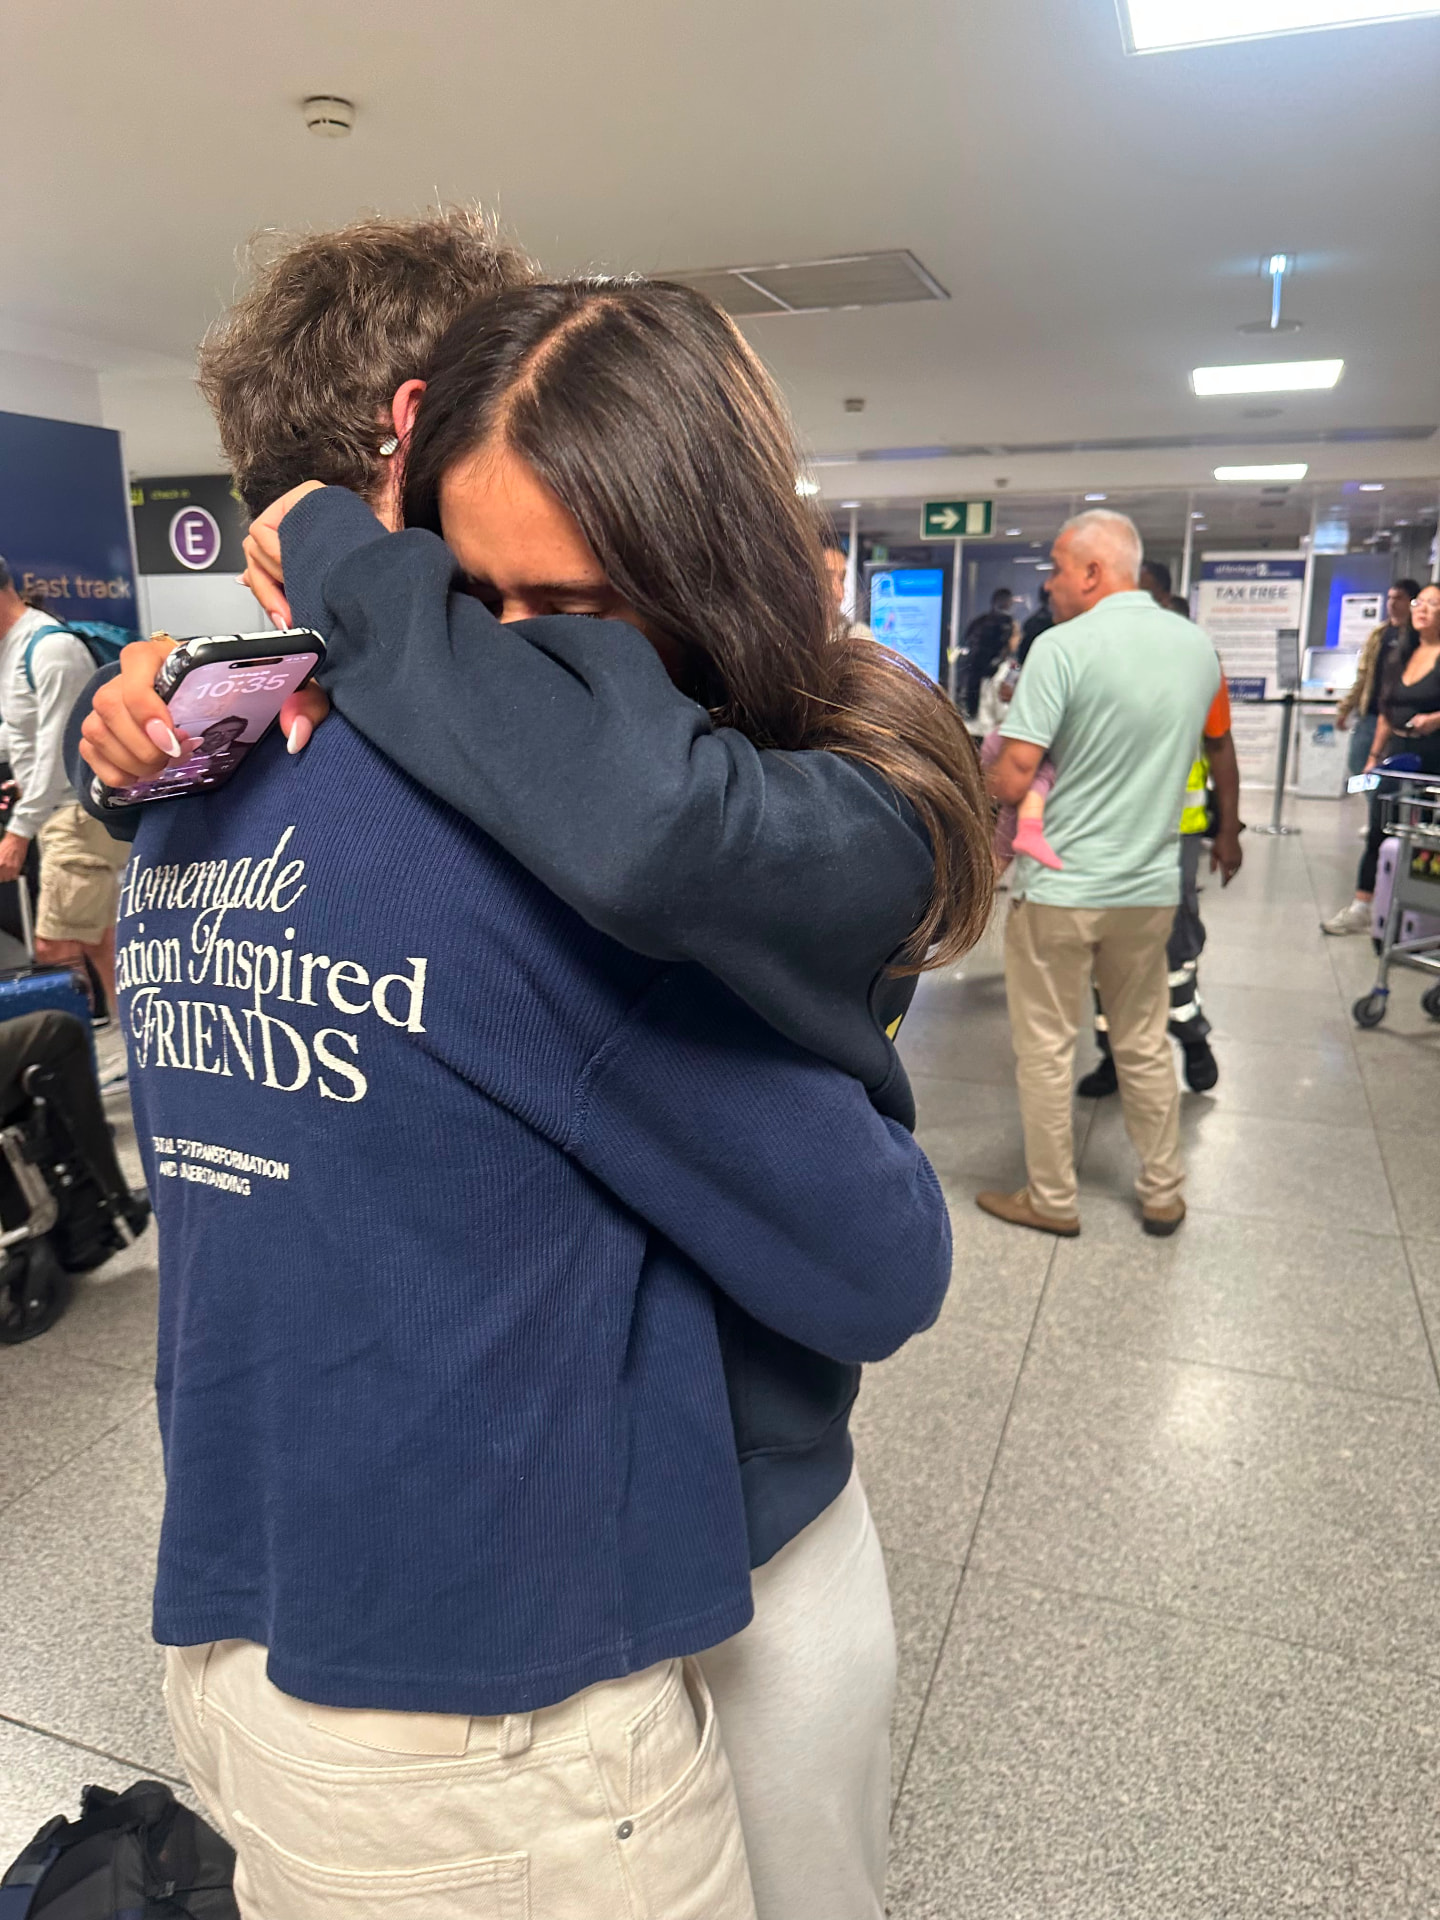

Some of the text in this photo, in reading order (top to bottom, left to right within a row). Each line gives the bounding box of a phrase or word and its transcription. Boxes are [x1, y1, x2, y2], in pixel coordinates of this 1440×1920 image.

[183, 521, 207, 555] E
[75, 575, 132, 599] track
[1215, 584, 1289, 599] TAX FREE
[195, 673, 290, 700] 10:35
[188, 905, 428, 1034] Inspired
[130, 987, 368, 1103] FRIENDS
